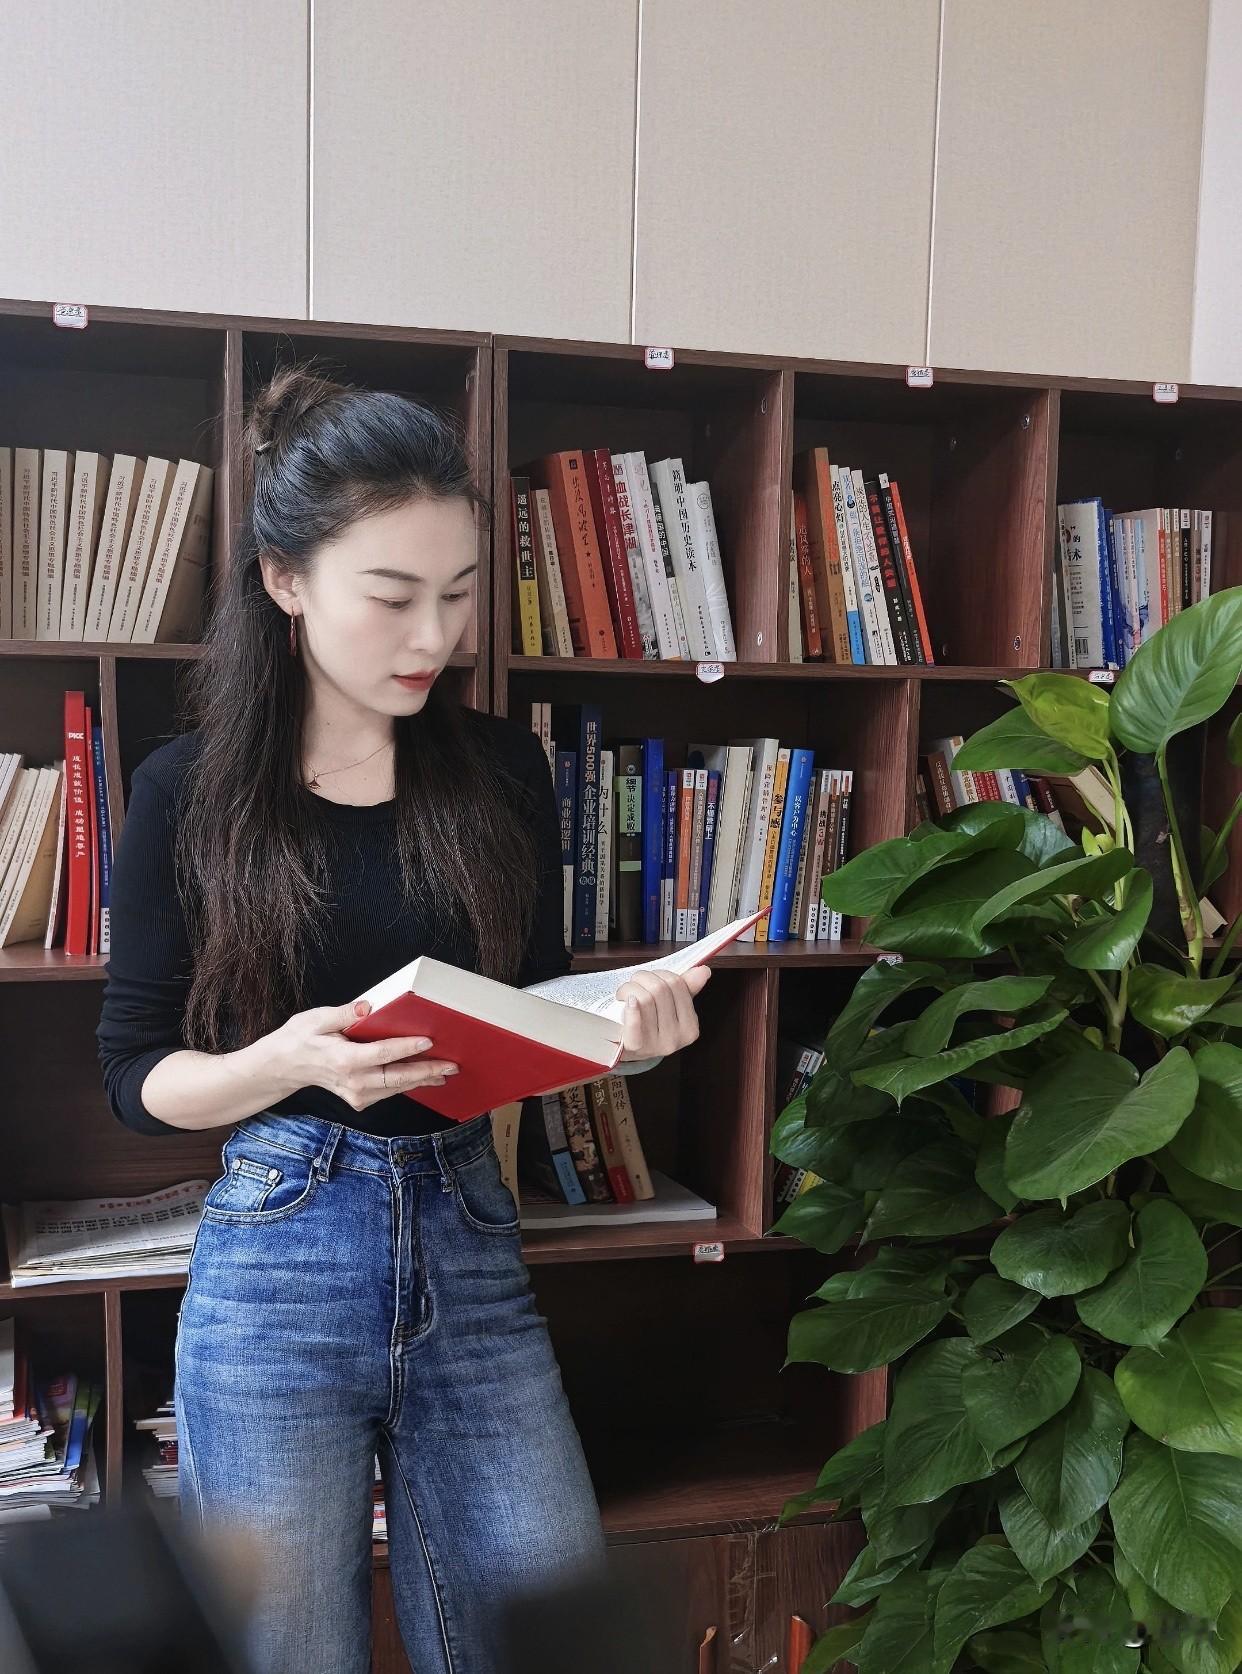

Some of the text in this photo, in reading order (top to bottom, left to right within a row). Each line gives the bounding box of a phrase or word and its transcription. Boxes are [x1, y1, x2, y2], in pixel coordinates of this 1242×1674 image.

[517, 494, 535, 580] 遥远的救世主
[614, 481, 637, 549] 血战长津湖
[672, 469, 698, 571] 简明中国历史读本
[798, 525, 812, 576] 追风筝的人
[68, 732, 84, 740] PICC
[597, 786, 608, 835] 为什么
[626, 778, 637, 831] 细节决定成败
[769, 794, 784, 828] 参与感
[791, 795, 803, 836] 以客户为中心
